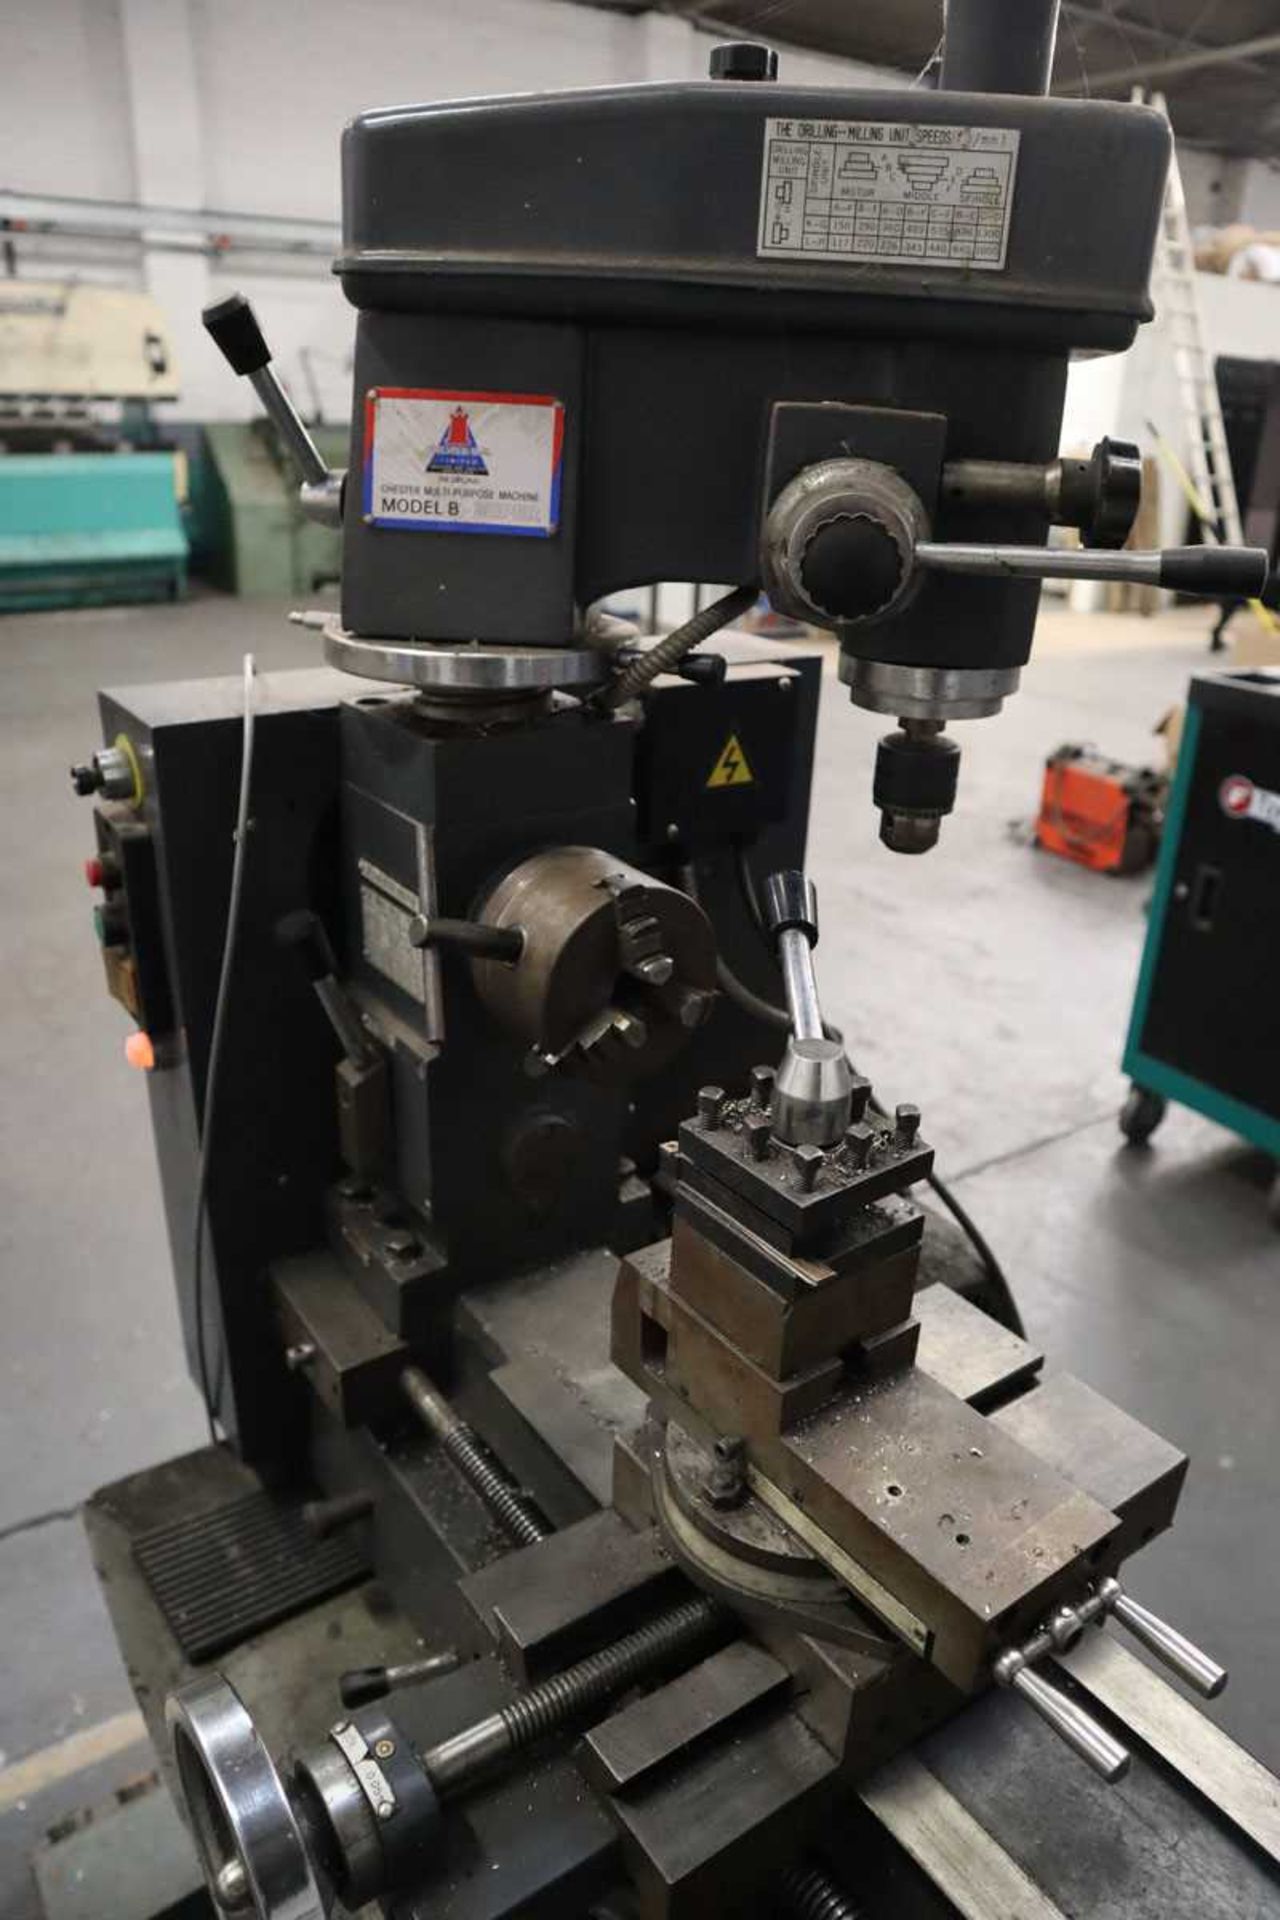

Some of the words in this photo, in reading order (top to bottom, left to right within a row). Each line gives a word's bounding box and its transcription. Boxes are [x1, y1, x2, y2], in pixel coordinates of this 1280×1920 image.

[776, 121, 792, 137] THE
[889, 128, 910, 141] UNIT
[916, 129, 951, 144] SPEEDS
[903, 191, 939, 201] MIDDLE
[382, 484, 421, 496] CHESTER
[498, 490, 539, 502] MACHINE
[381, 498, 442, 515] MODEL
